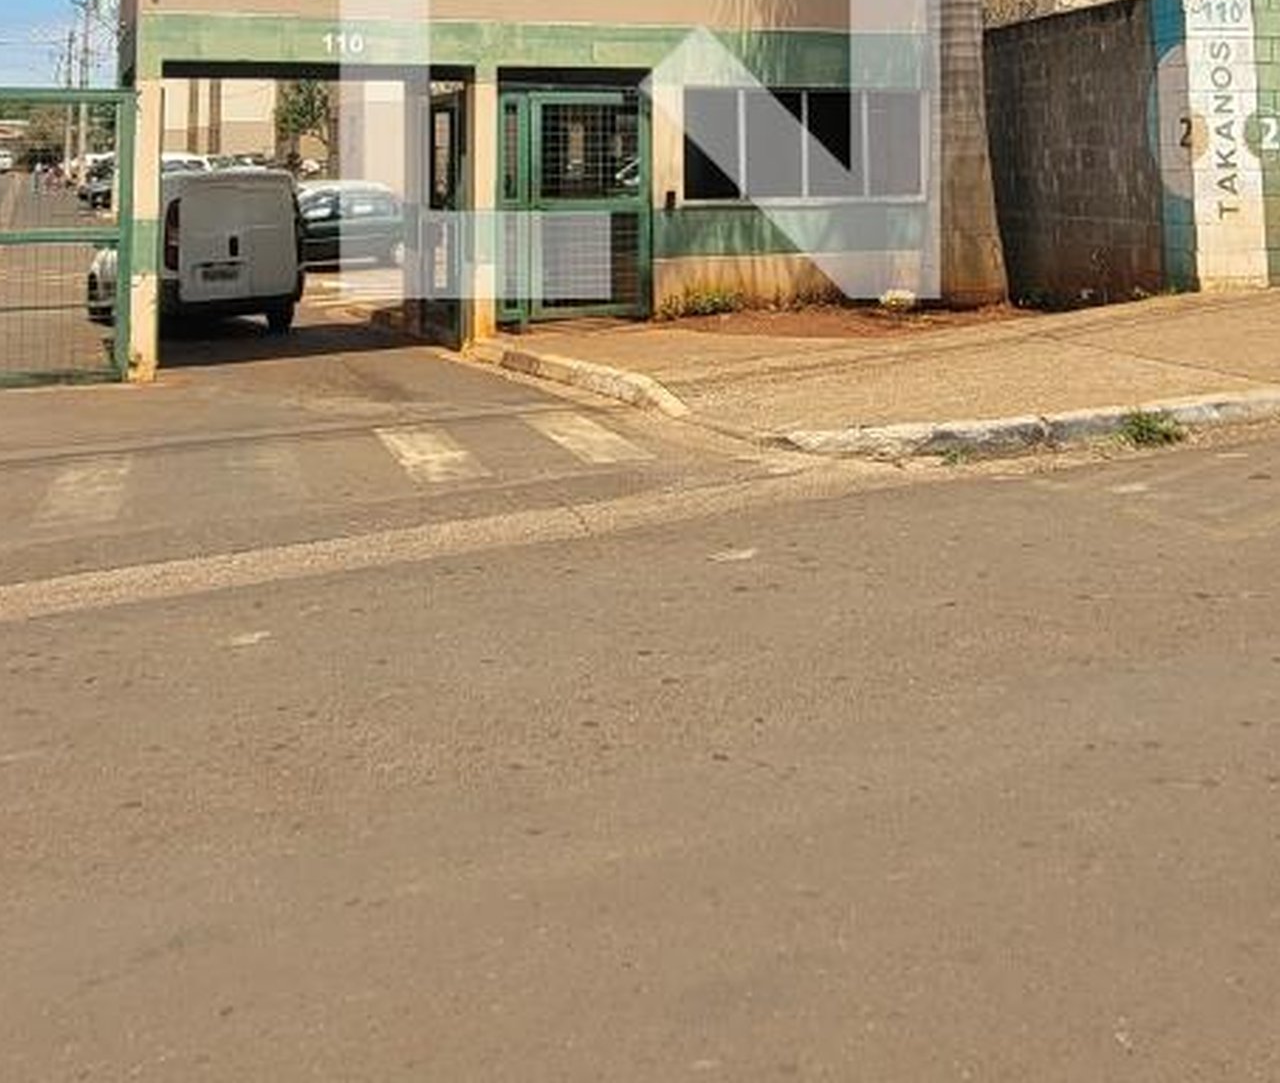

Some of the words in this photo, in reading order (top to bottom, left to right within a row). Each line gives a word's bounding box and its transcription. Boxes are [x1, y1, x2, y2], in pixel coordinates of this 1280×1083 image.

[322, 32, 364, 53] 110
[1210, 41, 1240, 220] TAKANOS
[1261, 117, 1280, 151] 2
